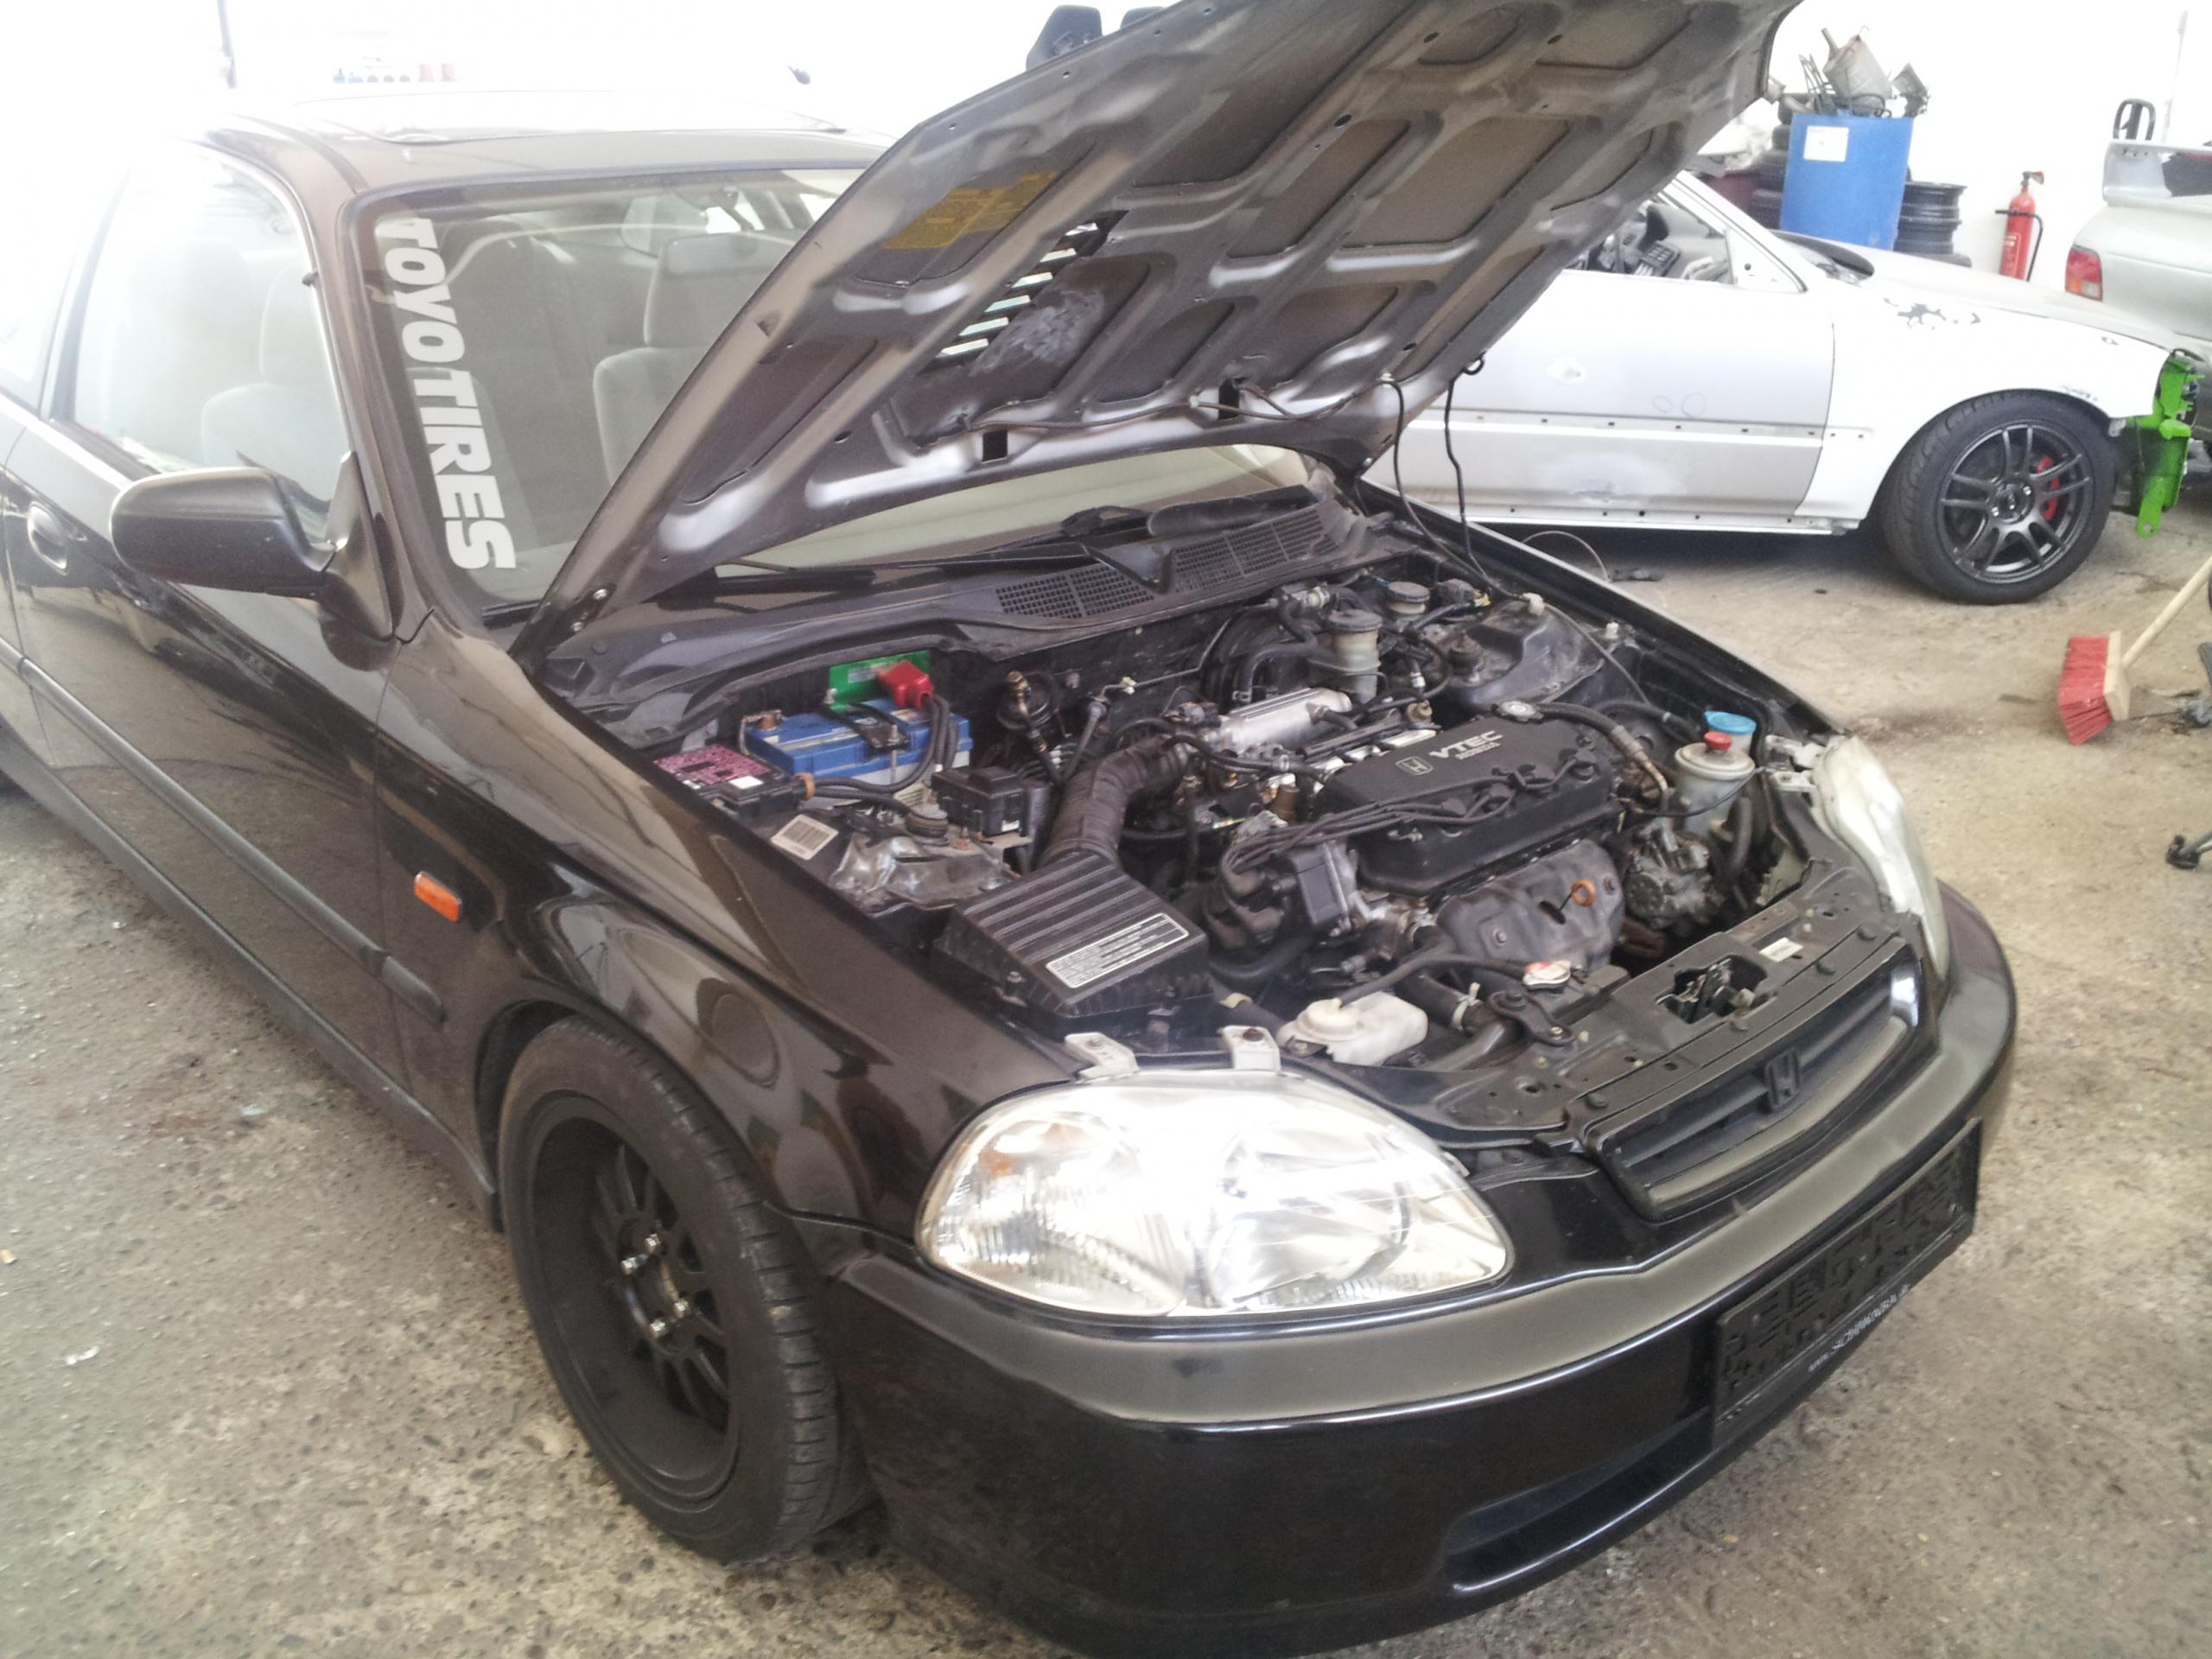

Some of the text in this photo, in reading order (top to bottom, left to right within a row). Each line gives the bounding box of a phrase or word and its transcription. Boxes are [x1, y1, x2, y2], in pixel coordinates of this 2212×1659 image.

[375, 218, 517, 569] TOYO TIRES
[1428, 730, 1503, 759] VTEC
